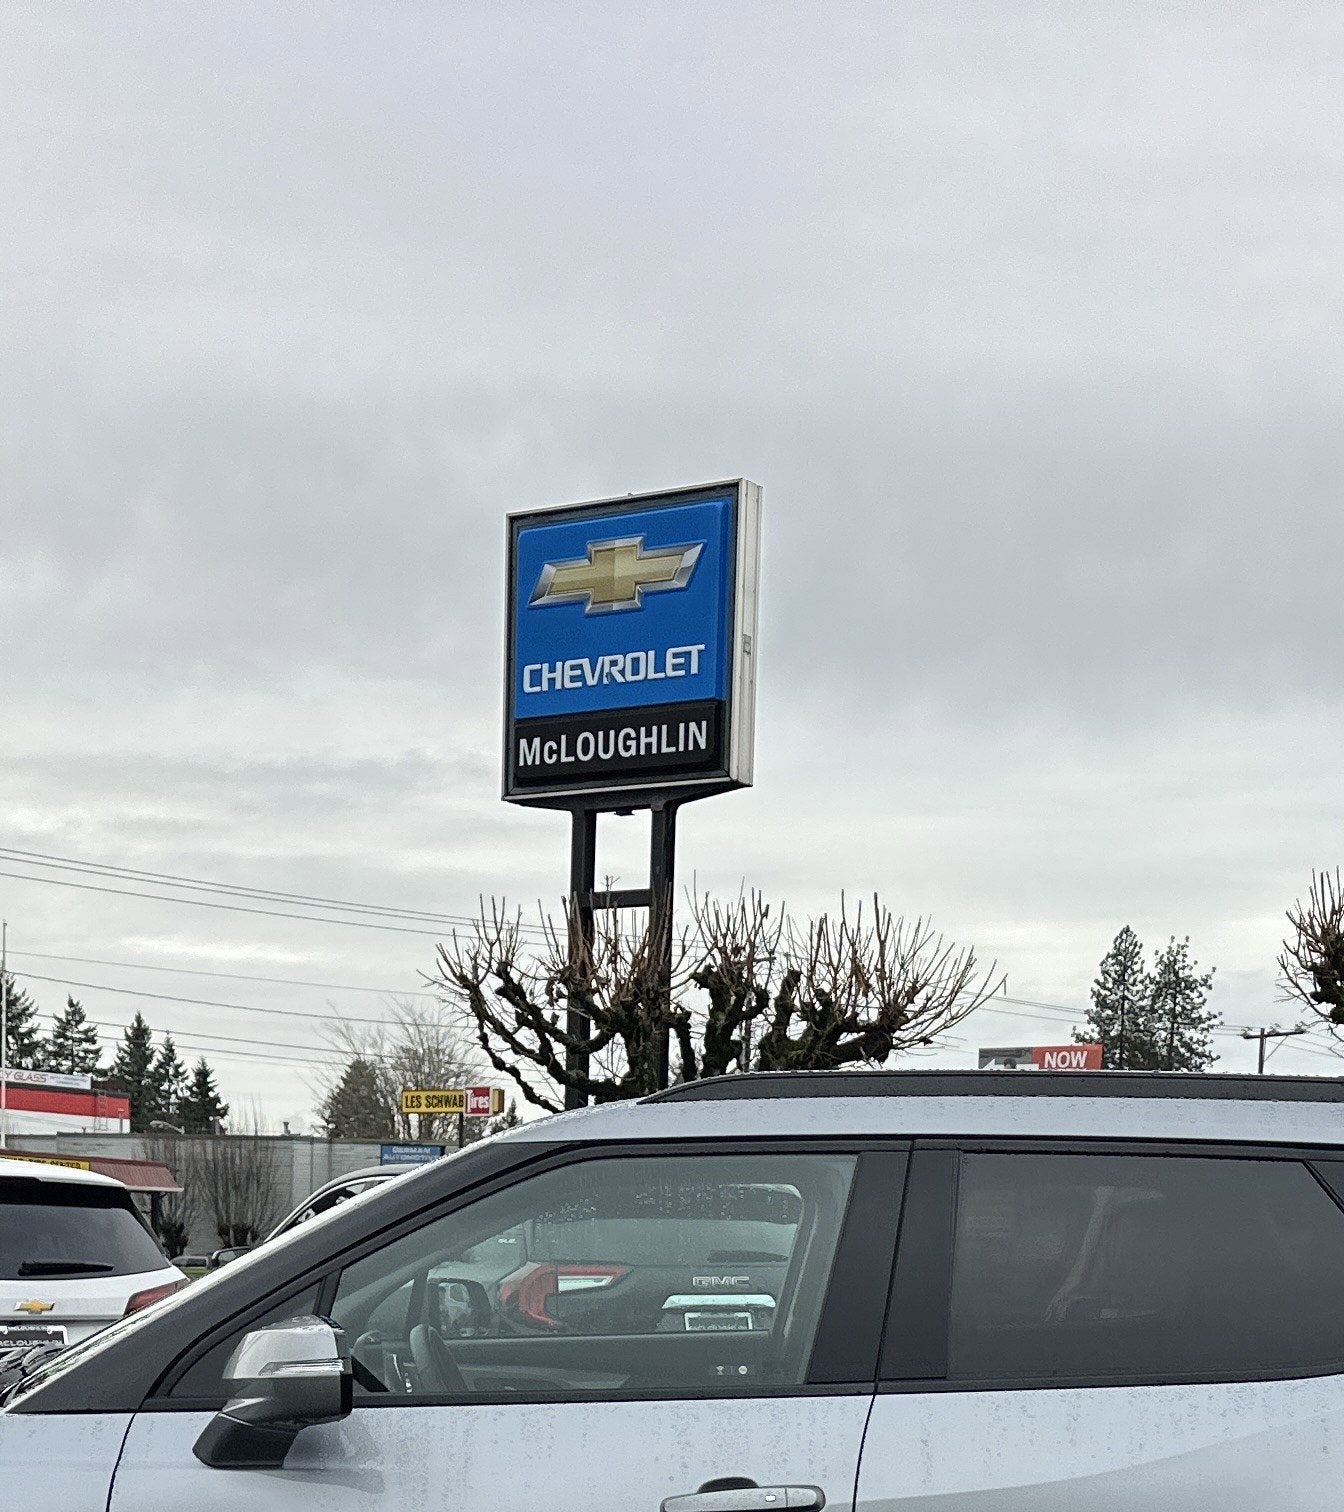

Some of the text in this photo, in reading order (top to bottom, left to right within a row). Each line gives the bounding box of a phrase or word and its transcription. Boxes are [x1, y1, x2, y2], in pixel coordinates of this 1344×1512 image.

[522, 643, 706, 694] CHEVROLET
[518, 720, 708, 768] McLOUGHLIN
[1044, 1051, 1088, 1069] NOW
[13, 1071, 49, 1083] GLASS
[404, 1094, 422, 1109] LES
[424, 1094, 464, 1109] SCHWAB
[391, 1146, 431, 1154] GERMAN
[692, 1275, 751, 1287] GMC
